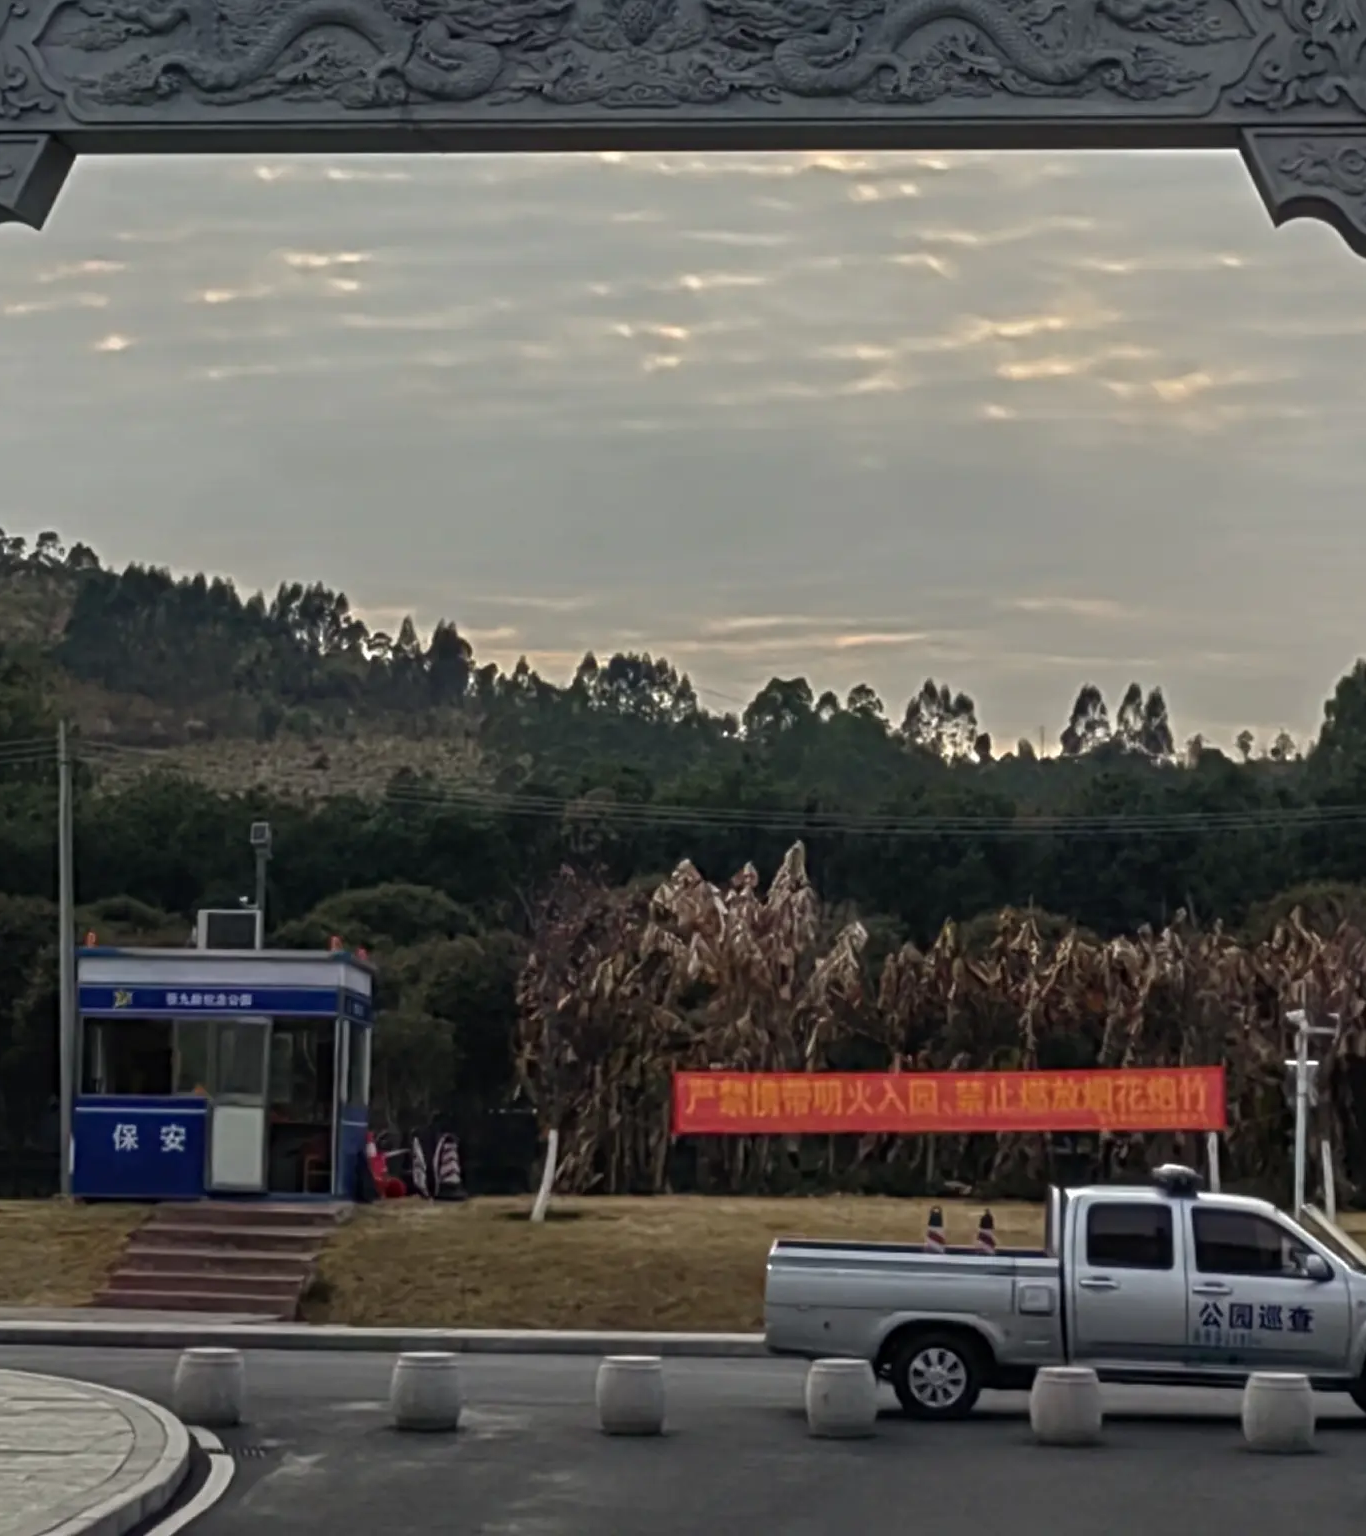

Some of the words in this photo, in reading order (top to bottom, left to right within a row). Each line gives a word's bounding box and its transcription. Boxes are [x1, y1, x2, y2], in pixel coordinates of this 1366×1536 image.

[112, 1123, 186, 1152] 保安
[1198, 1301, 1315, 1334] 公园巡查
